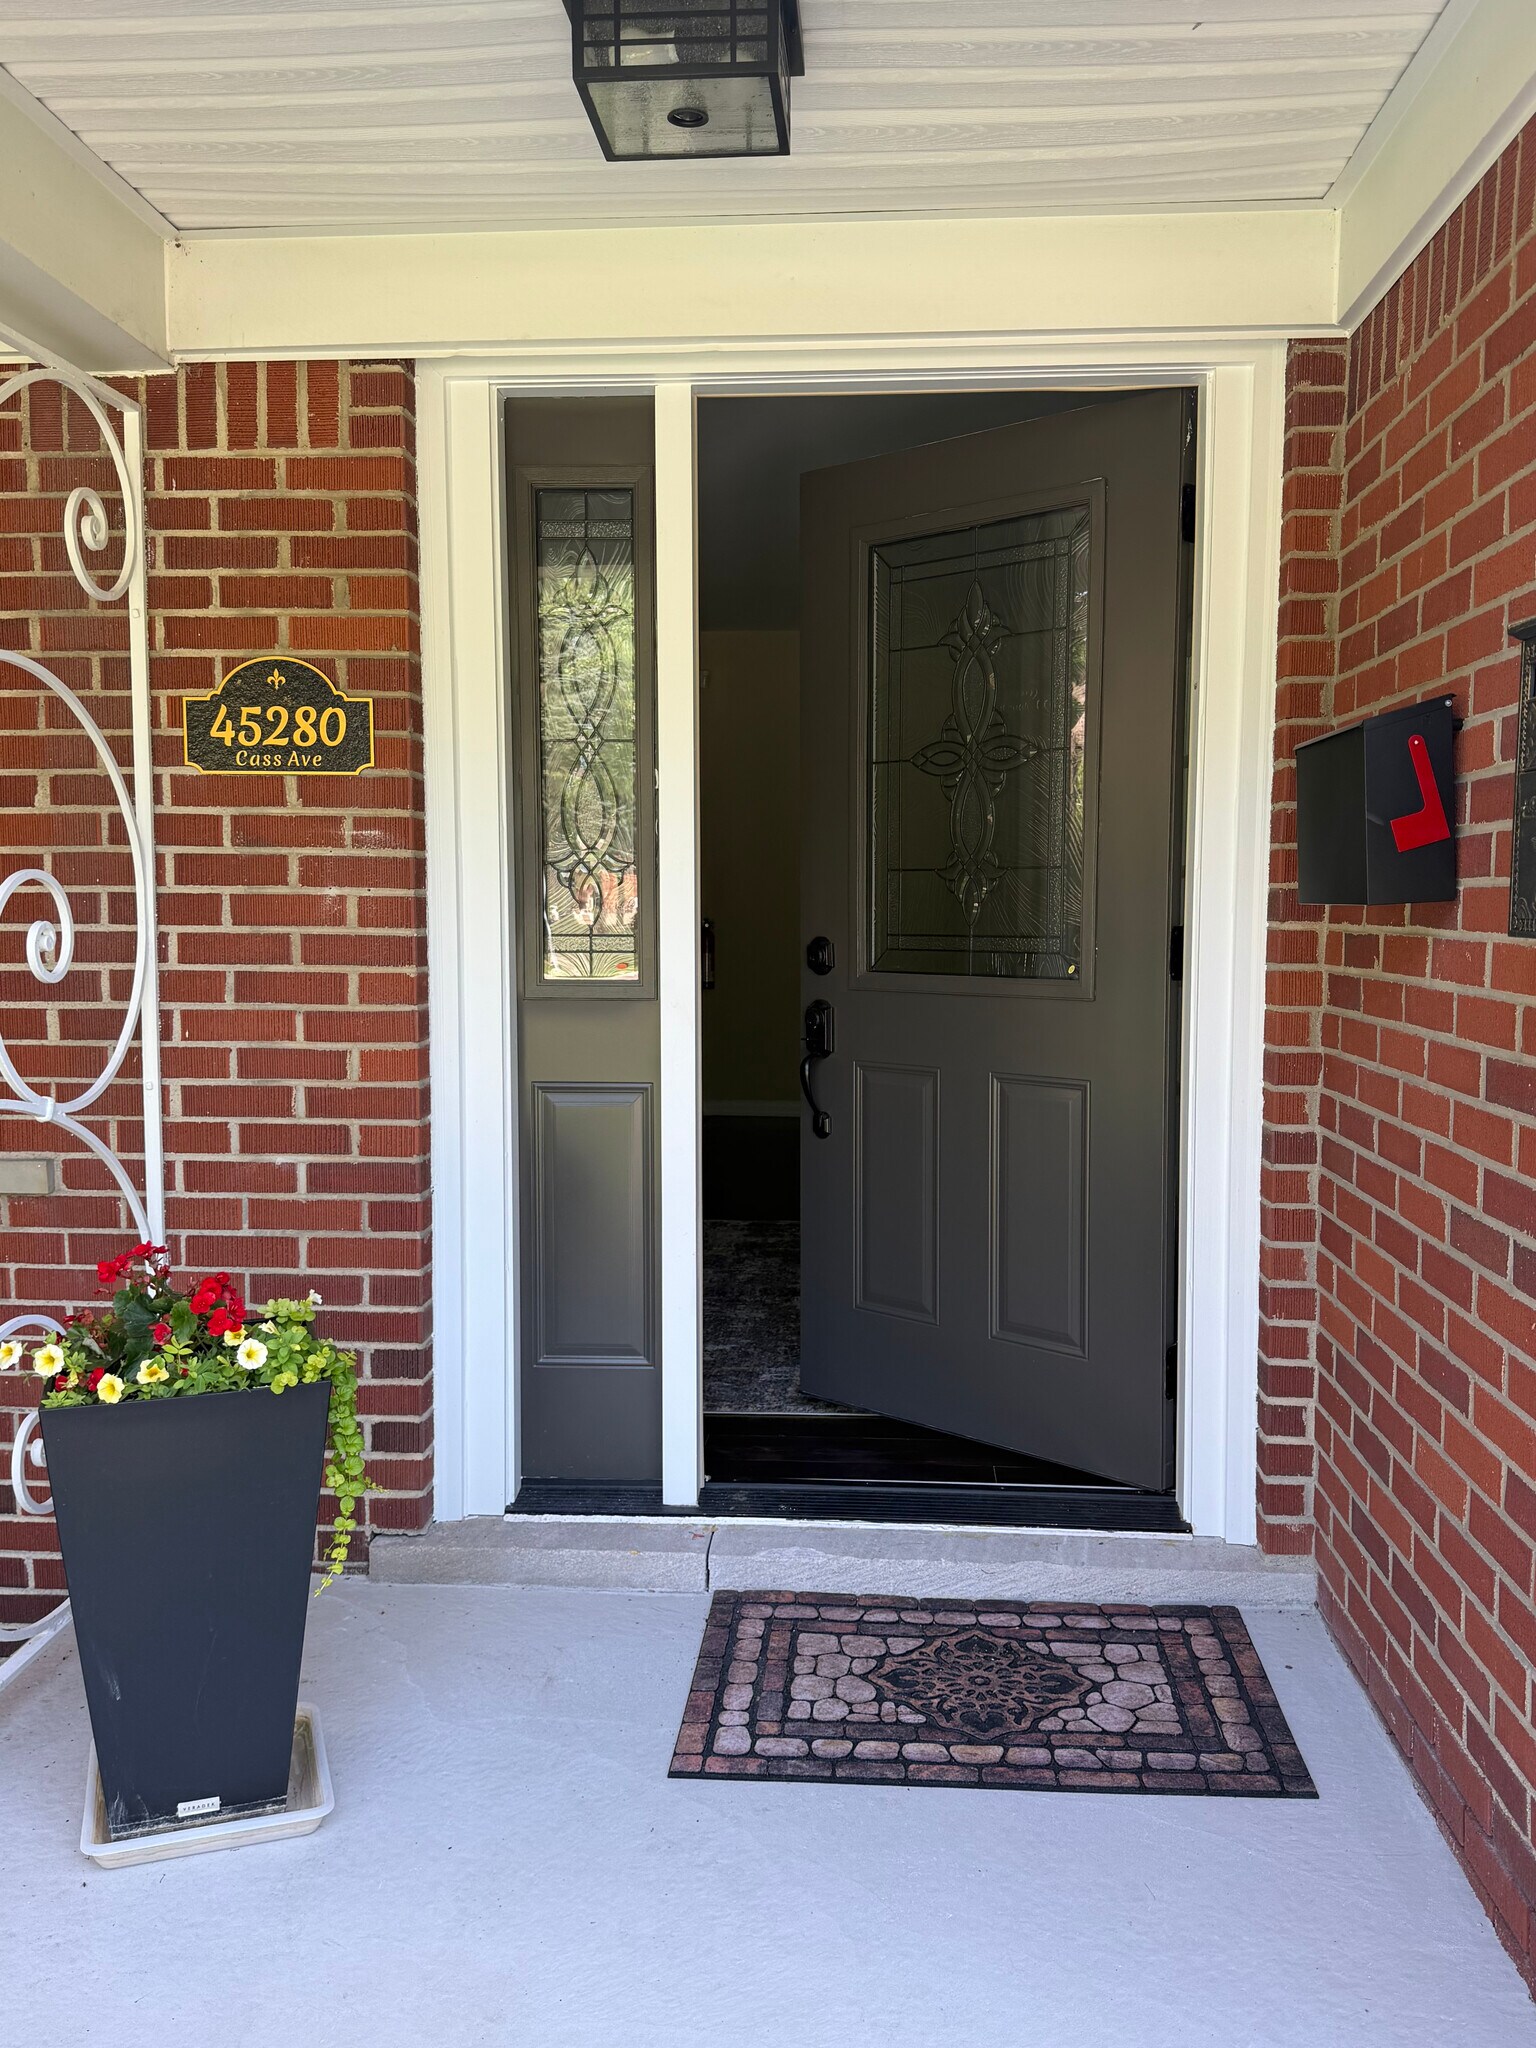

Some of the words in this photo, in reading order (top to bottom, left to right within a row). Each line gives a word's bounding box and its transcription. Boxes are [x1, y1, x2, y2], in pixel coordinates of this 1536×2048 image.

[210, 703, 347, 747] 45280
[235, 750, 282, 767] Cass
[287, 750, 322, 767] Ave
